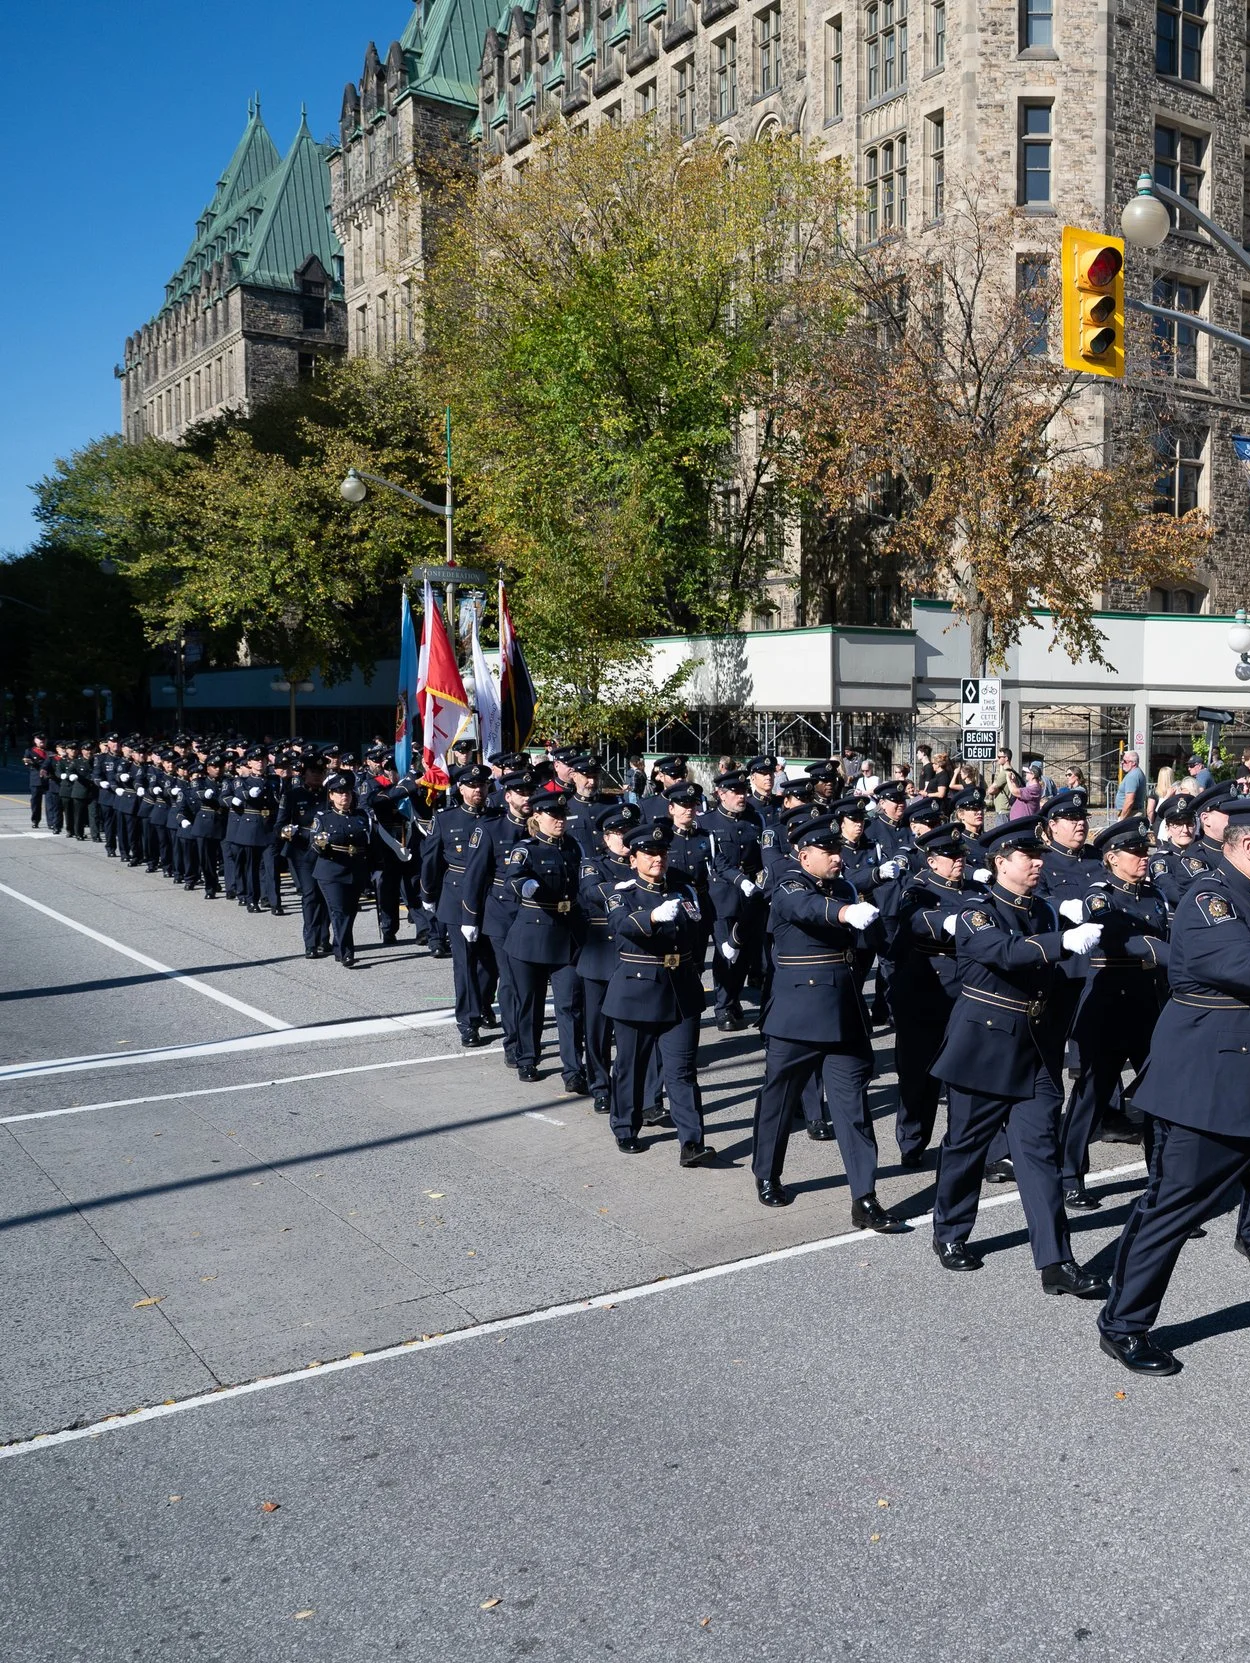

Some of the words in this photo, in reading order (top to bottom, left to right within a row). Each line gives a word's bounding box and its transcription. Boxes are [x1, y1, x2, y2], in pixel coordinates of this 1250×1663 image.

[966, 732, 994, 743] BEGINS
[967, 745, 993, 758] DÉBUT
[1214, 914, 1231, 923] Canada
